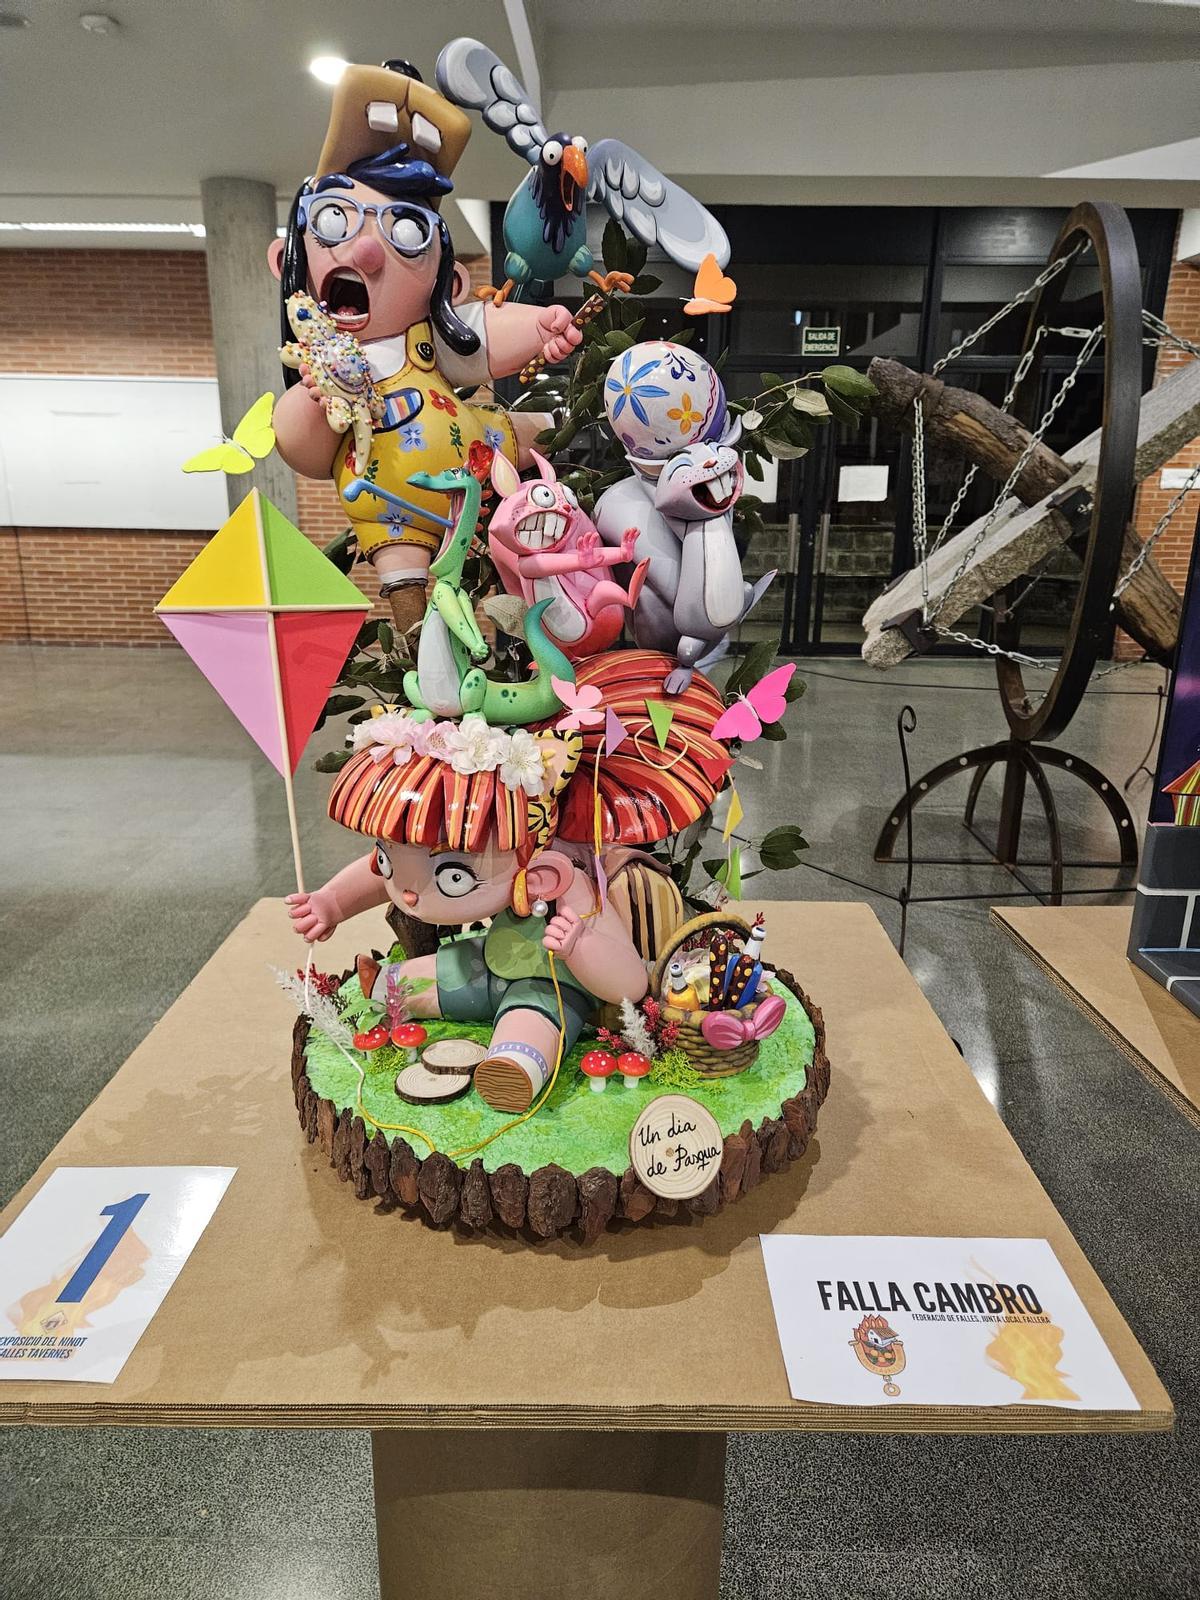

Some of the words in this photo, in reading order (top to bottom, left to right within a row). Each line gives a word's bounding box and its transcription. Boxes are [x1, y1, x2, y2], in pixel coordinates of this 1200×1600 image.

[638, 1124, 661, 1146] Un
[667, 1112, 697, 1138] dia
[647, 1154, 667, 1177] de
[673, 1144, 721, 1171] Pasqua
[55, 1193, 150, 1303] 1
[817, 1280, 912, 1312] FALLA
[913, 1281, 1043, 1315] CAMBRO
[946, 1314, 955, 1322] DE
[982, 1315, 1001, 1323] JUNTA
[1001, 1316, 1023, 1324] LOCAL
[1023, 1316, 1051, 1324] FALLERA
[28, 1348, 73, 1359] TAVERNES
[41, 1336, 58, 1347] DEL
[58, 1337, 88, 1347] NINOT
